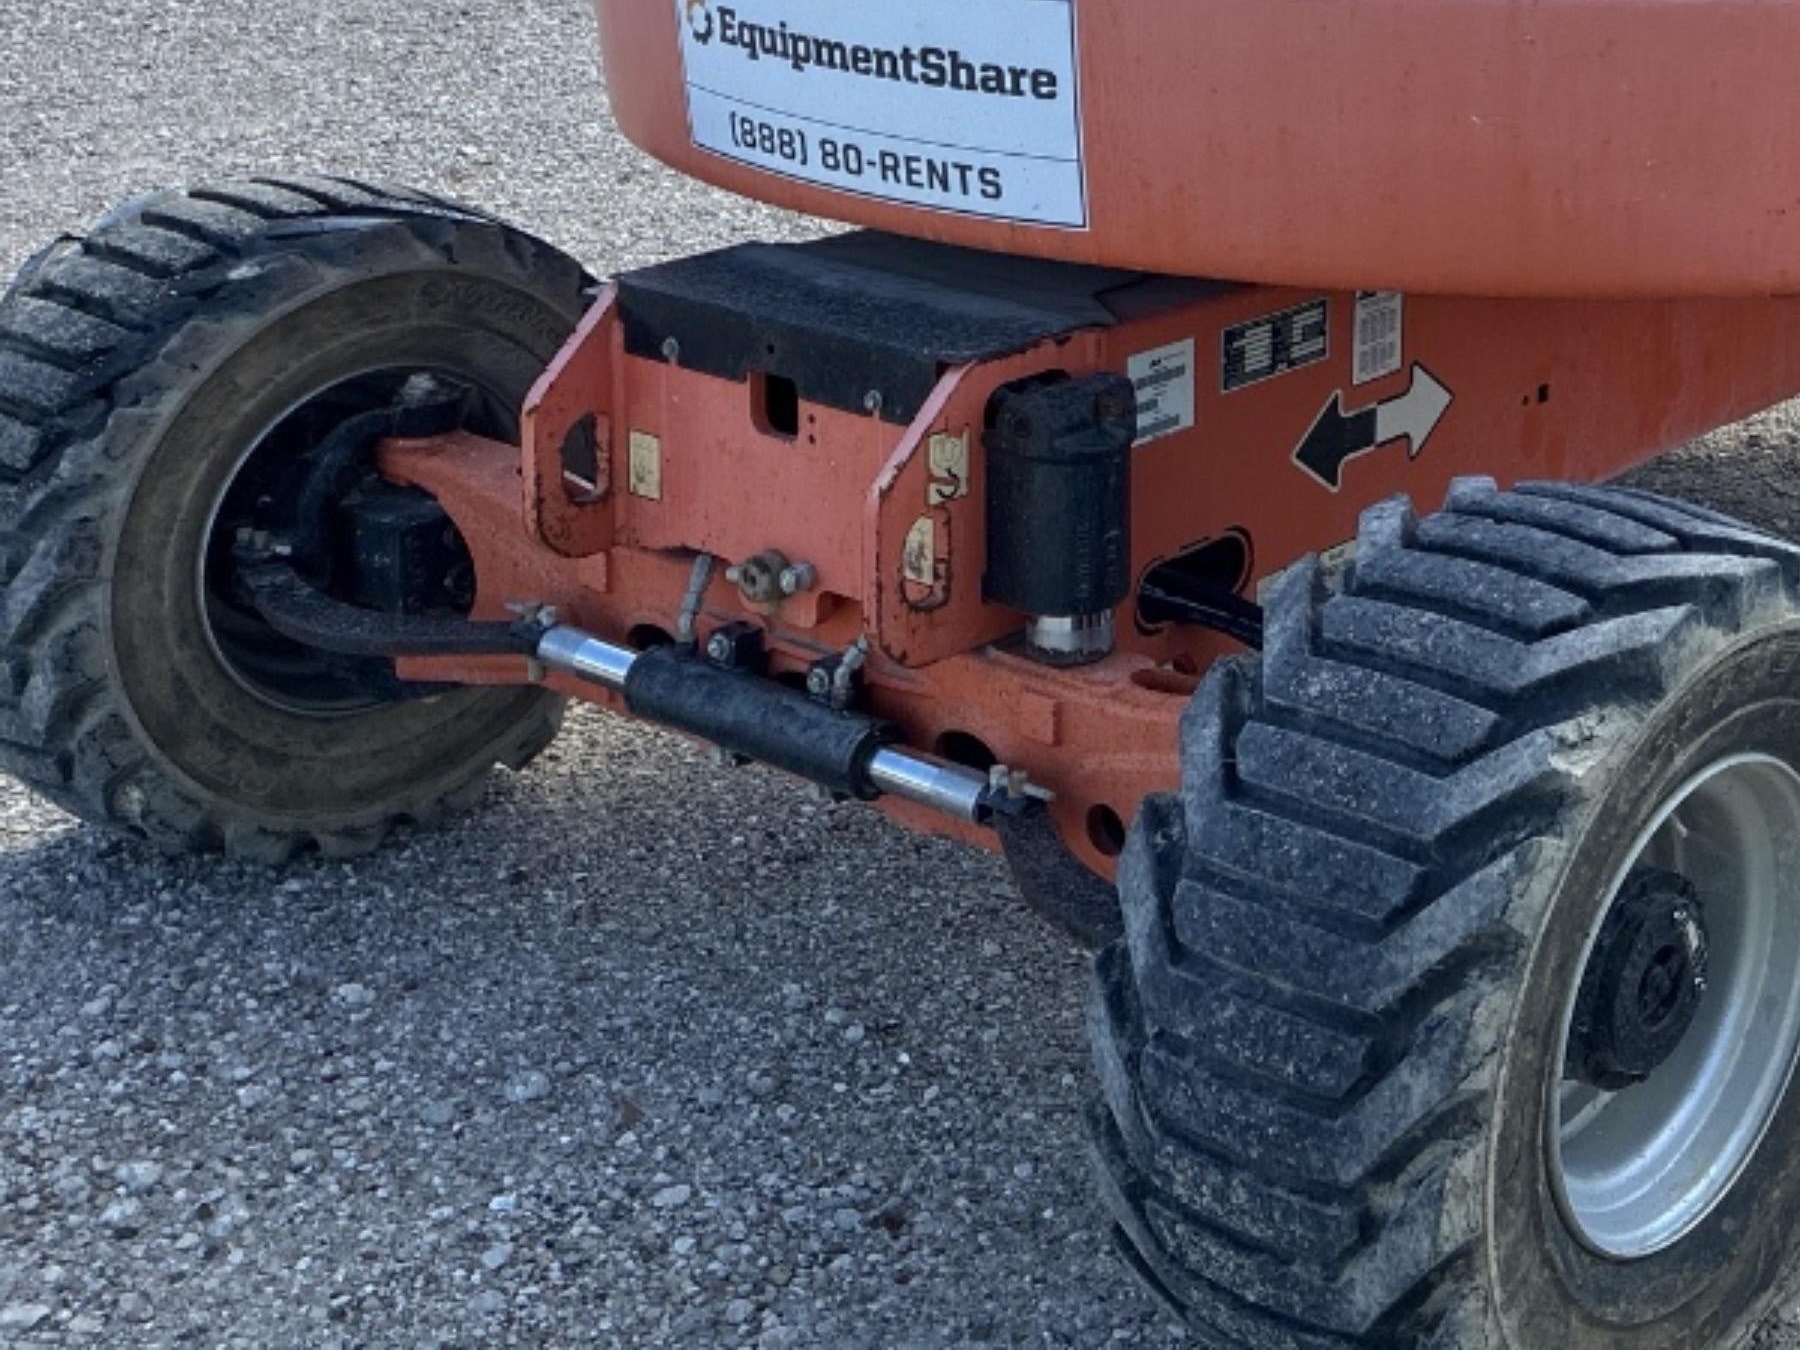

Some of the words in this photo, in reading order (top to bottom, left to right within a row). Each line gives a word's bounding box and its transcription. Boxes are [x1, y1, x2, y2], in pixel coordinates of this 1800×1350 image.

[716, 5, 1057, 100] EquipmentShare
[728, 110, 806, 166] (888)
[820, 139, 1003, 200] 80-RENTS
